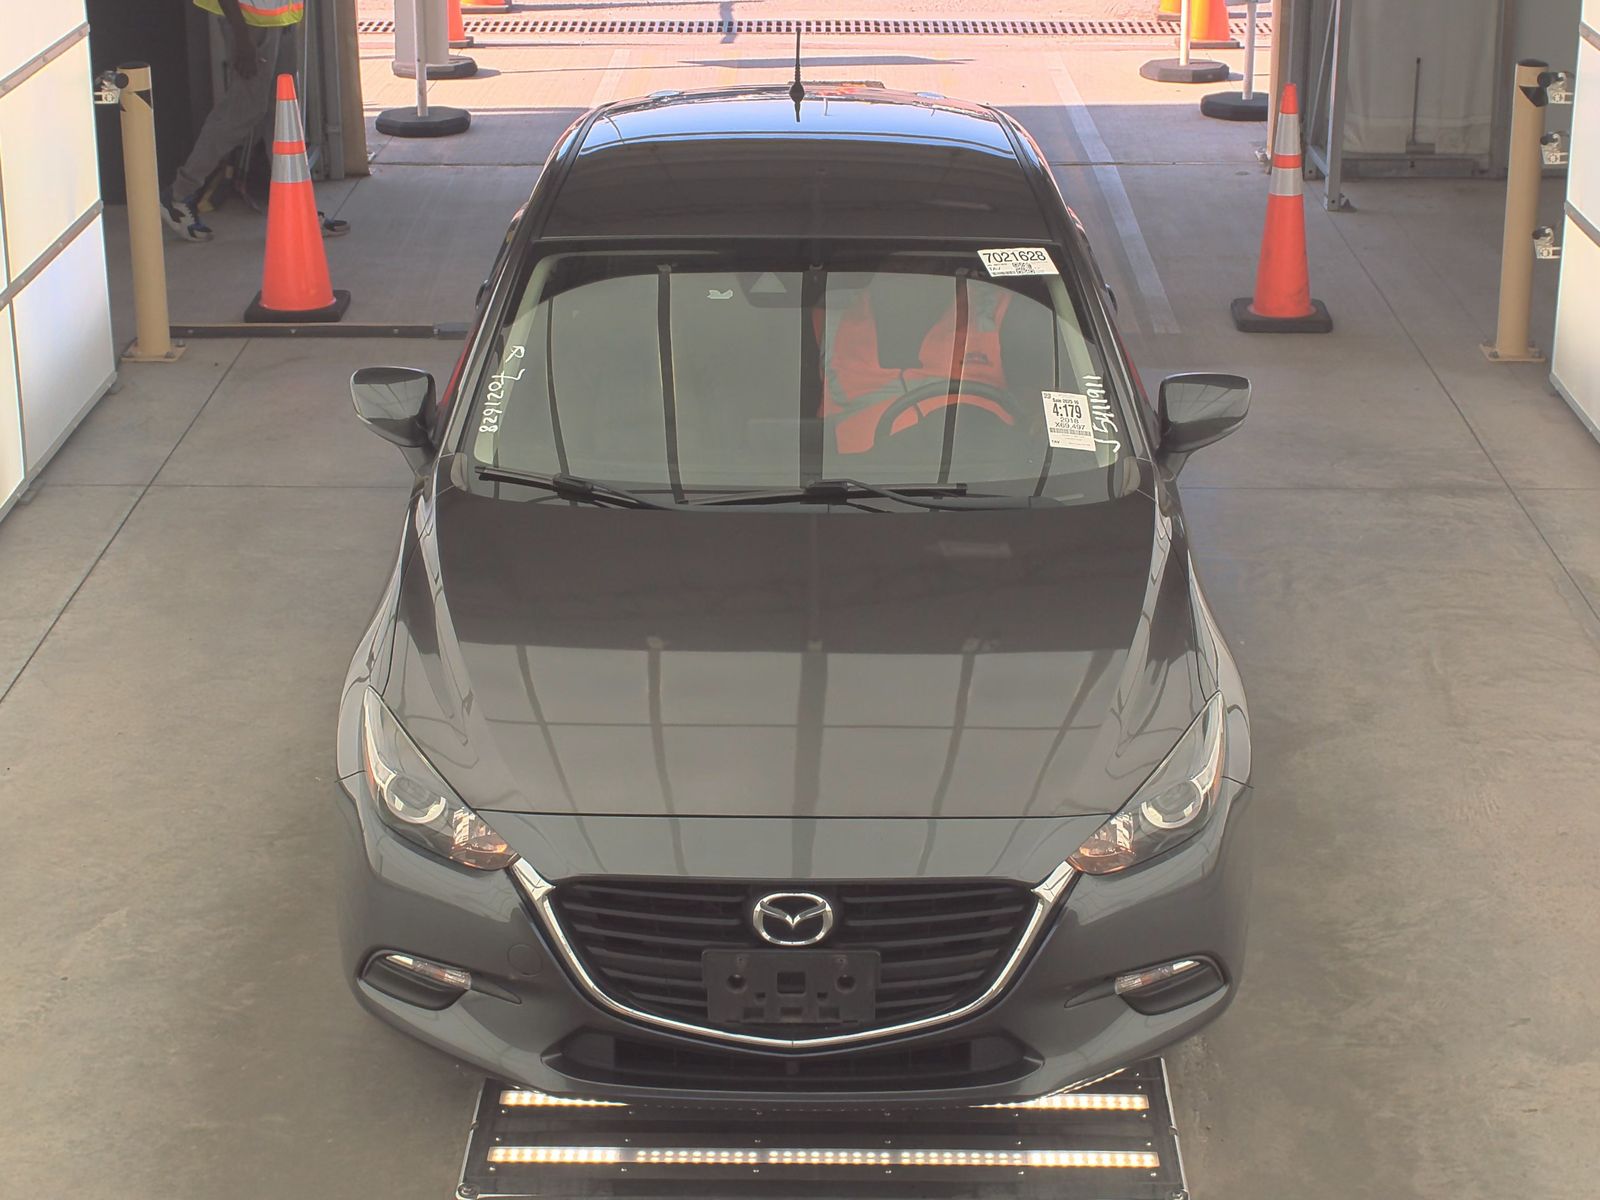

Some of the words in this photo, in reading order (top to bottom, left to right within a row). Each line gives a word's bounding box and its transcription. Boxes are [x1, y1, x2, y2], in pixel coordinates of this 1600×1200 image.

[982, 250, 1046, 263] 7021628
[479, 367, 526, 433] 7021628
[1052, 403, 1082, 419] 4:179
